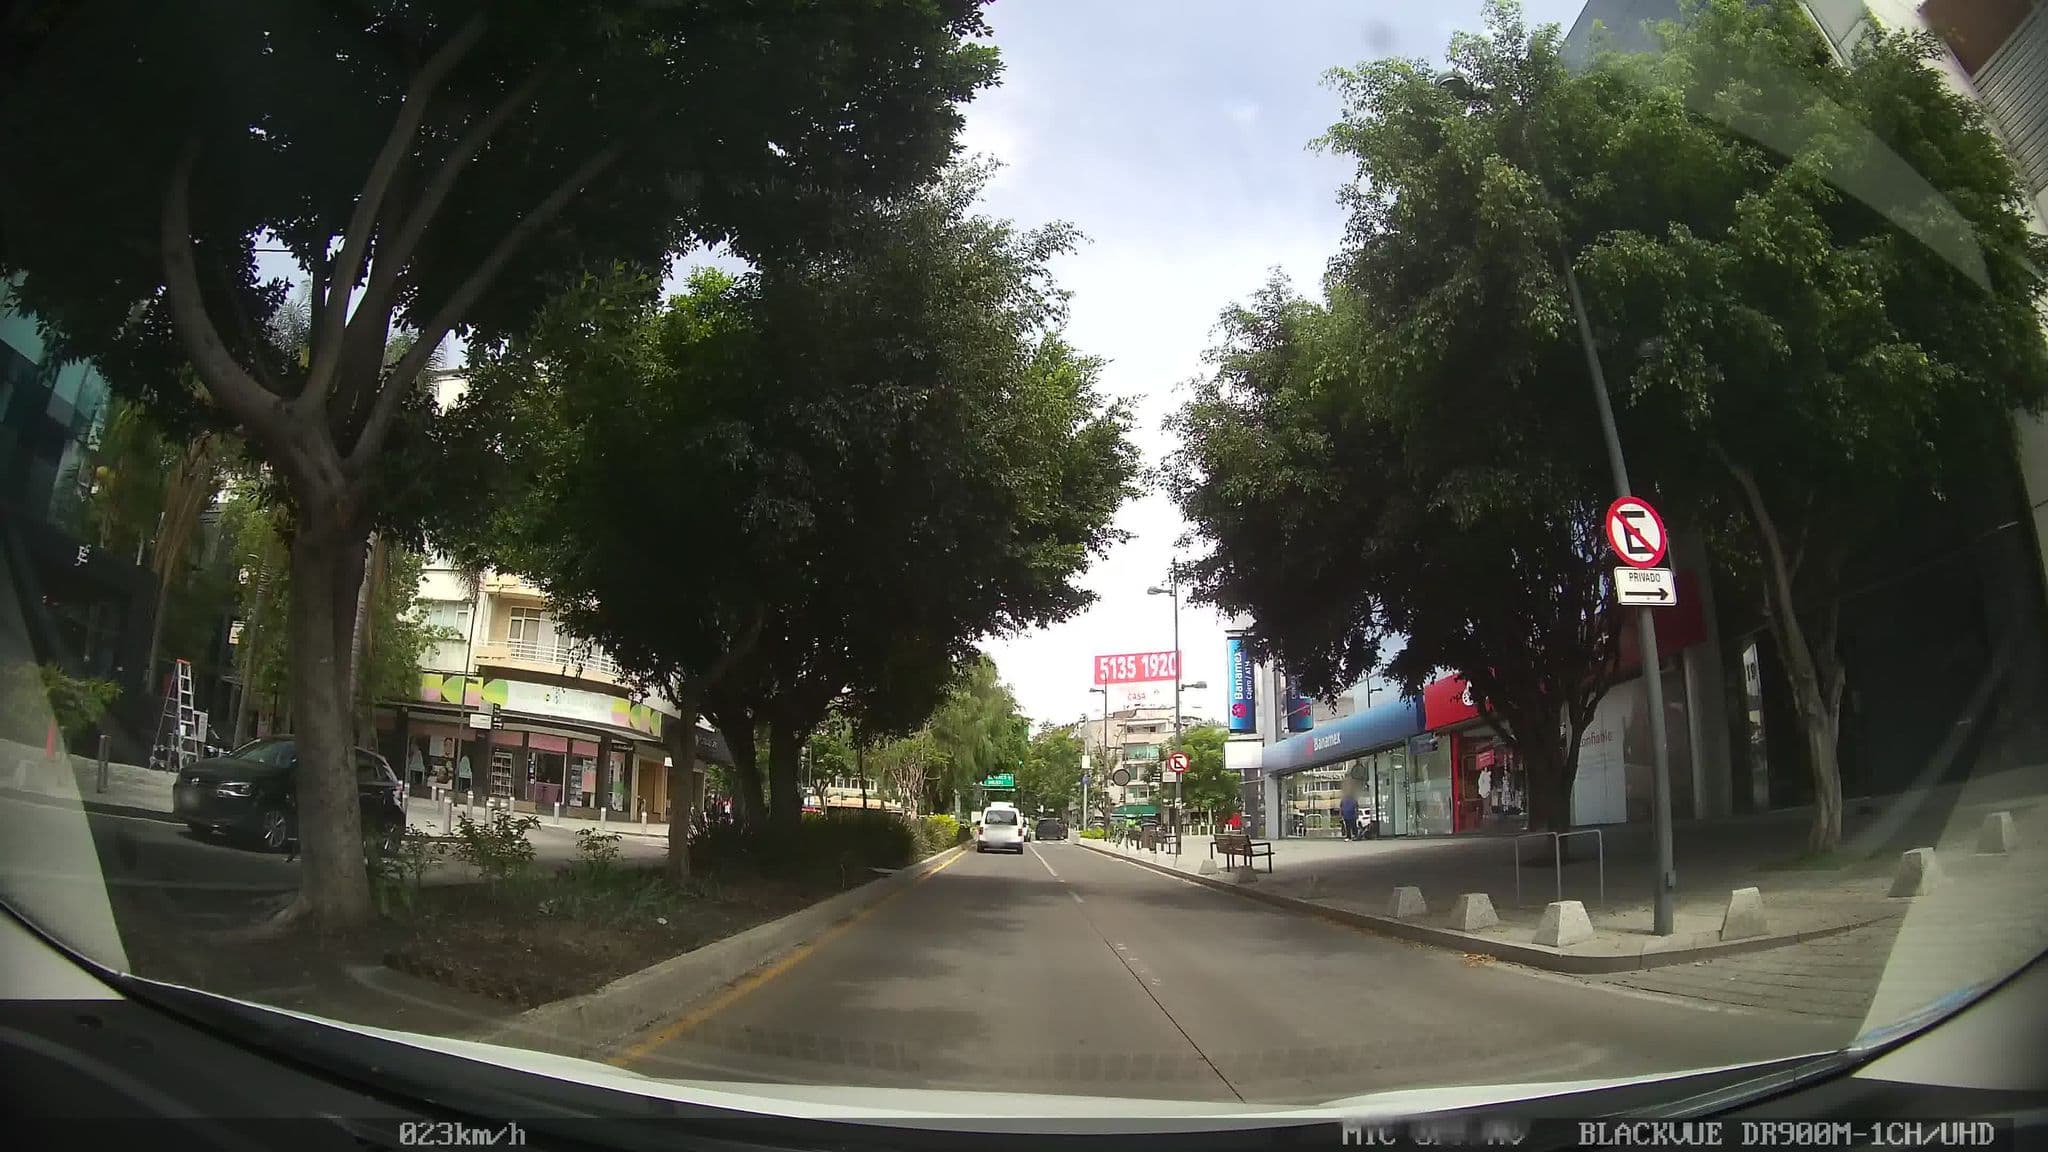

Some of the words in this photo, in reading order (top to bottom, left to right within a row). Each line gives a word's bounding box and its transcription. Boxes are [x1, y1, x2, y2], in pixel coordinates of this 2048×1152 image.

[1628, 572, 1661, 583] PRIVADO
[1100, 656, 1137, 681] 5135
[1141, 653, 1176, 678] 1920
[1234, 651, 1244, 700] Banamex
[1313, 732, 1341, 751] Banamex
